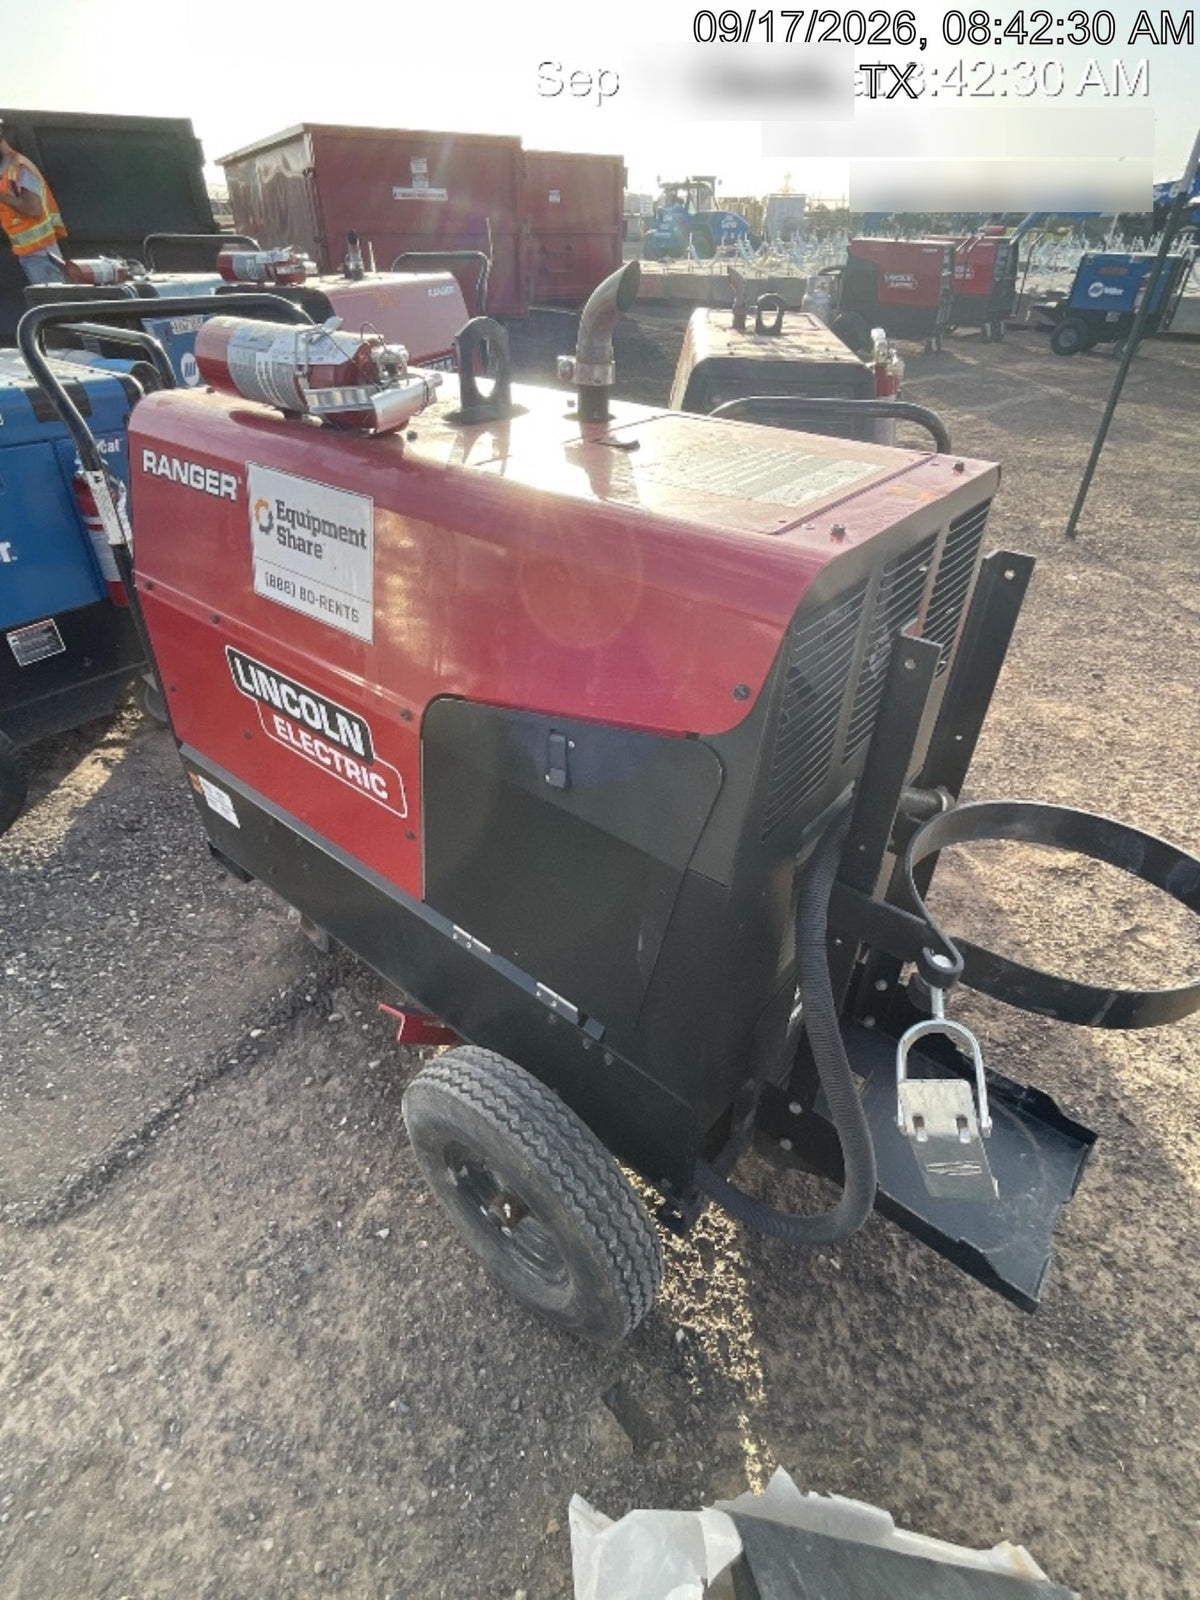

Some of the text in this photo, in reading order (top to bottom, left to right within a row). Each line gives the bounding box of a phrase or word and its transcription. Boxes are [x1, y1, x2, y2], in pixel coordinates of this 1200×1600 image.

[142, 449, 238, 500] RANGER
[275, 498, 367, 549] Equipment
[276, 524, 323, 559] Share
[264, 571, 296, 597] (888)
[234, 656, 365, 757] LINCOLN
[272, 713, 389, 800] ELECTRIC
